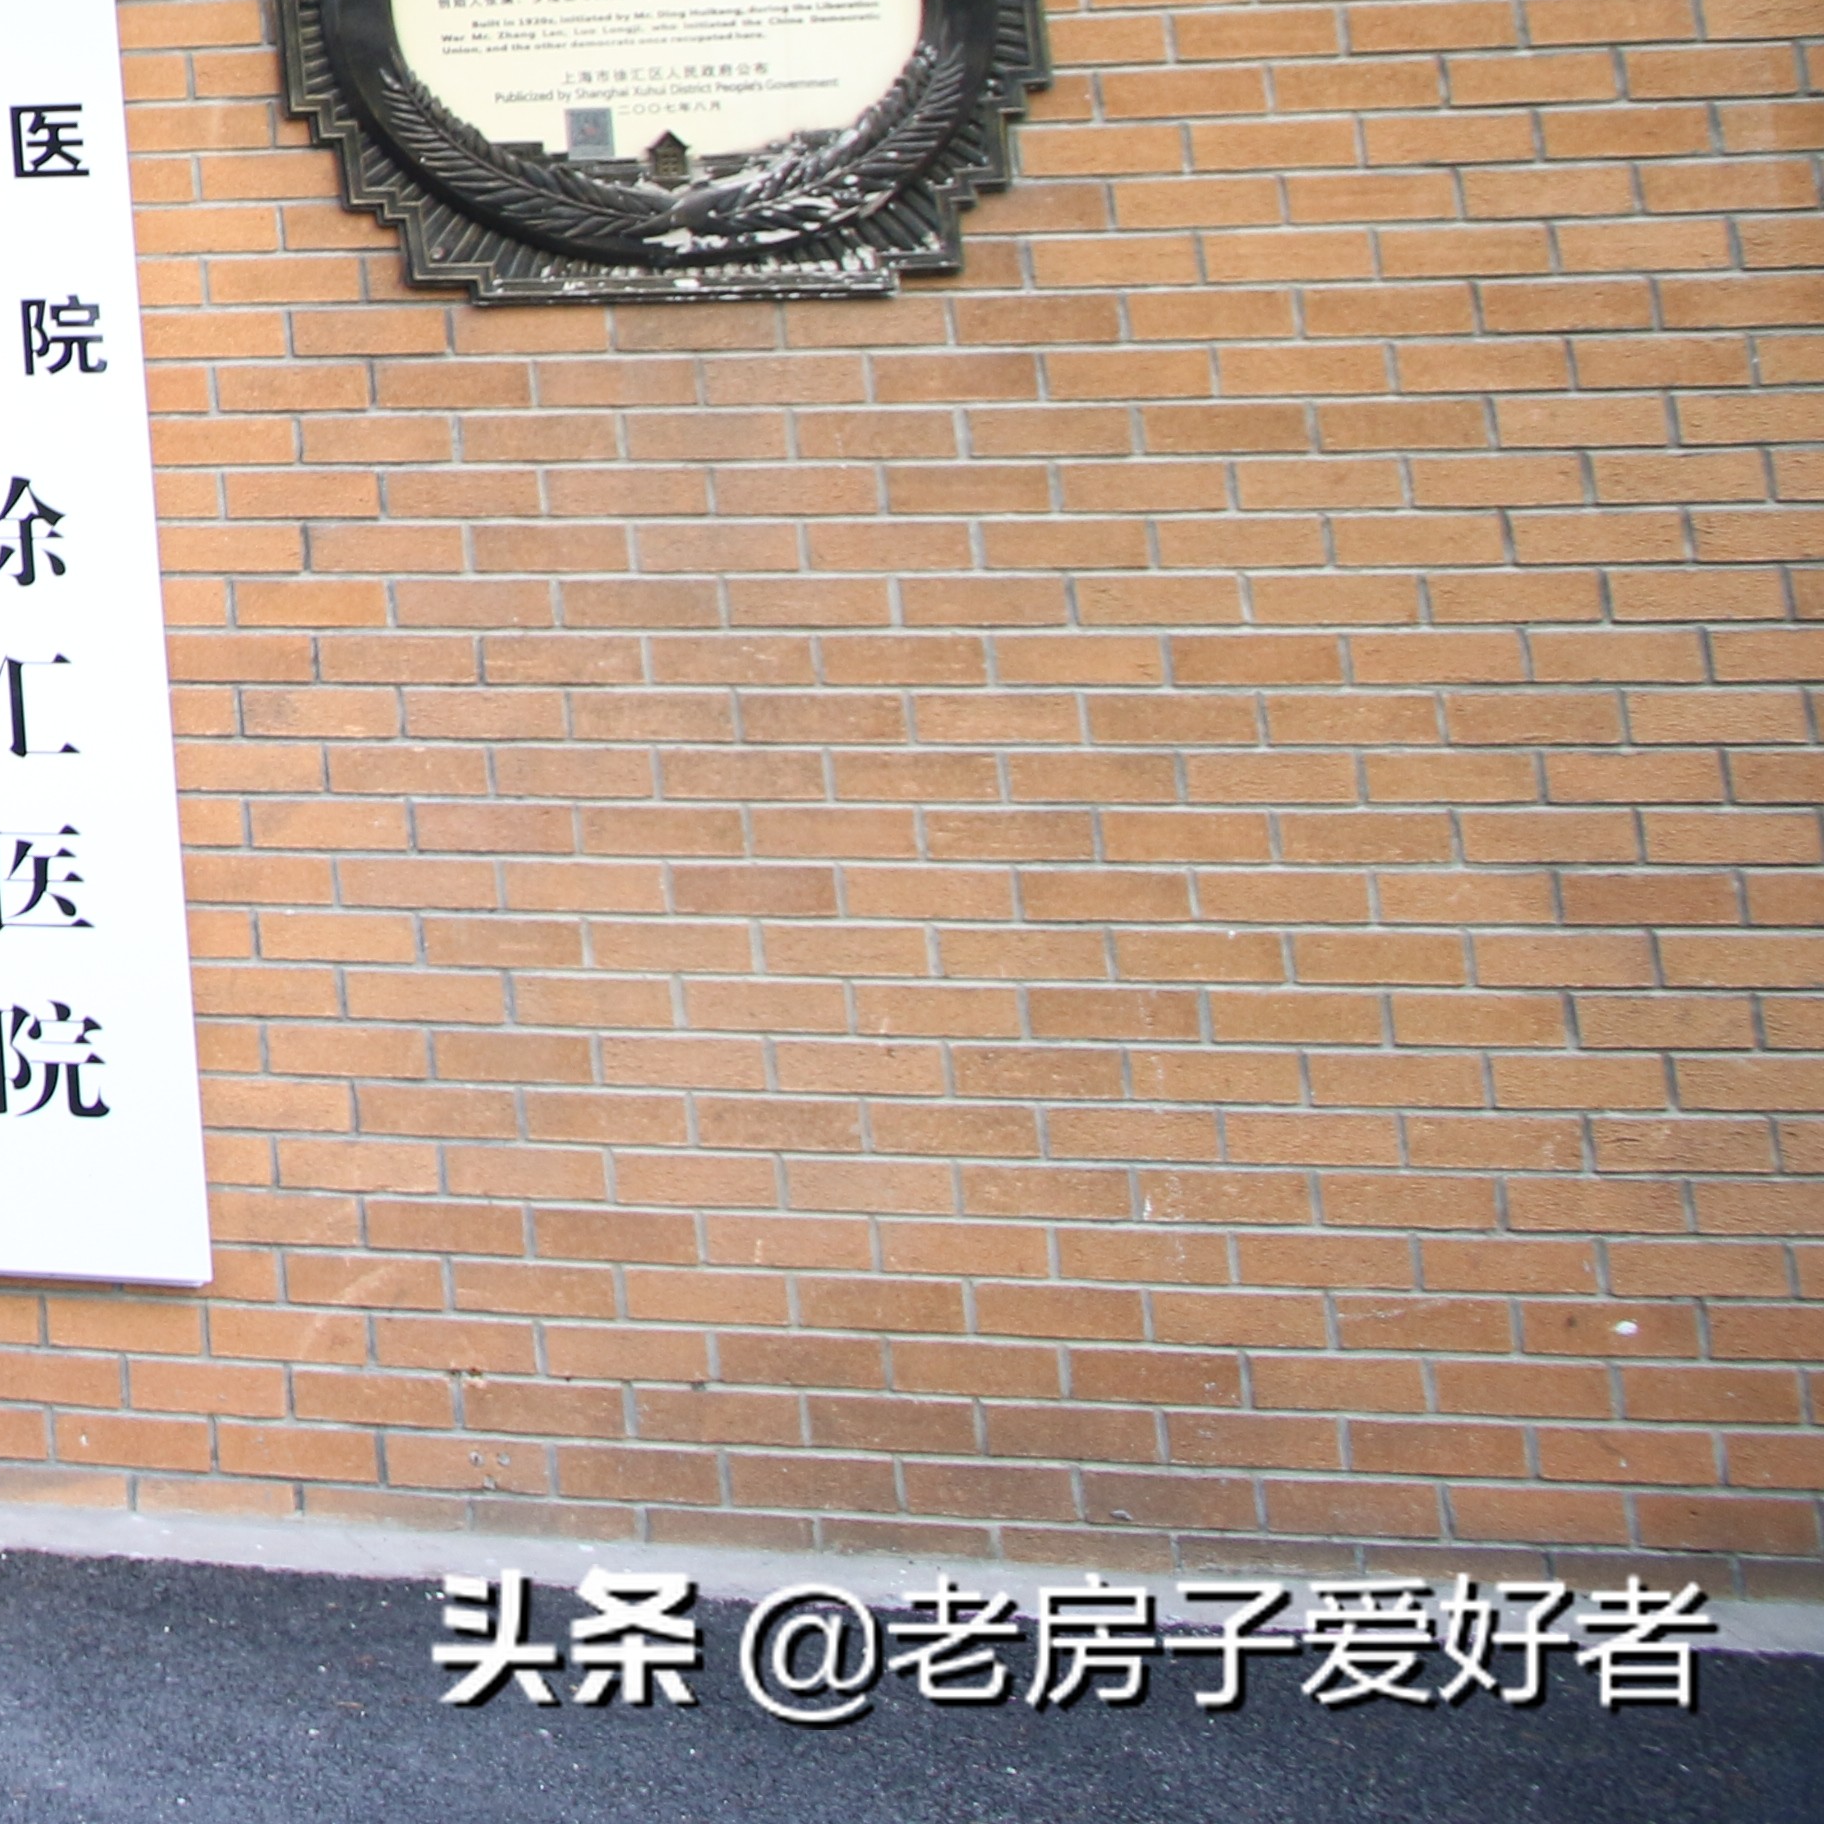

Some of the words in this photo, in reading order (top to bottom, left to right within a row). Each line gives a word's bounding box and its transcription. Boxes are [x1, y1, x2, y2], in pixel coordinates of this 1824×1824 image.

[472, 19, 500, 28] Built
[503, 19, 515, 27] in
[615, 13, 629, 22] by
[748, 4, 789, 14] during
[441, 34, 465, 42] War
[497, 30, 536, 40] Zhang
[442, 45, 482, 55] Union,
[485, 44, 508, 53] and
[511, 42, 530, 51] the
[534, 41, 567, 50] other
[561, 61, 768, 85] 上海市徐汇区人民政府公布
[495, 88, 553, 103] Publicized
[557, 89, 571, 103] by
[575, 87, 629, 101] Shanghai
[633, 84, 666, 96] Xuhui
[670, 83, 711, 95] District
[715, 79, 762, 95] People's
[766, 77, 839, 91] Government
